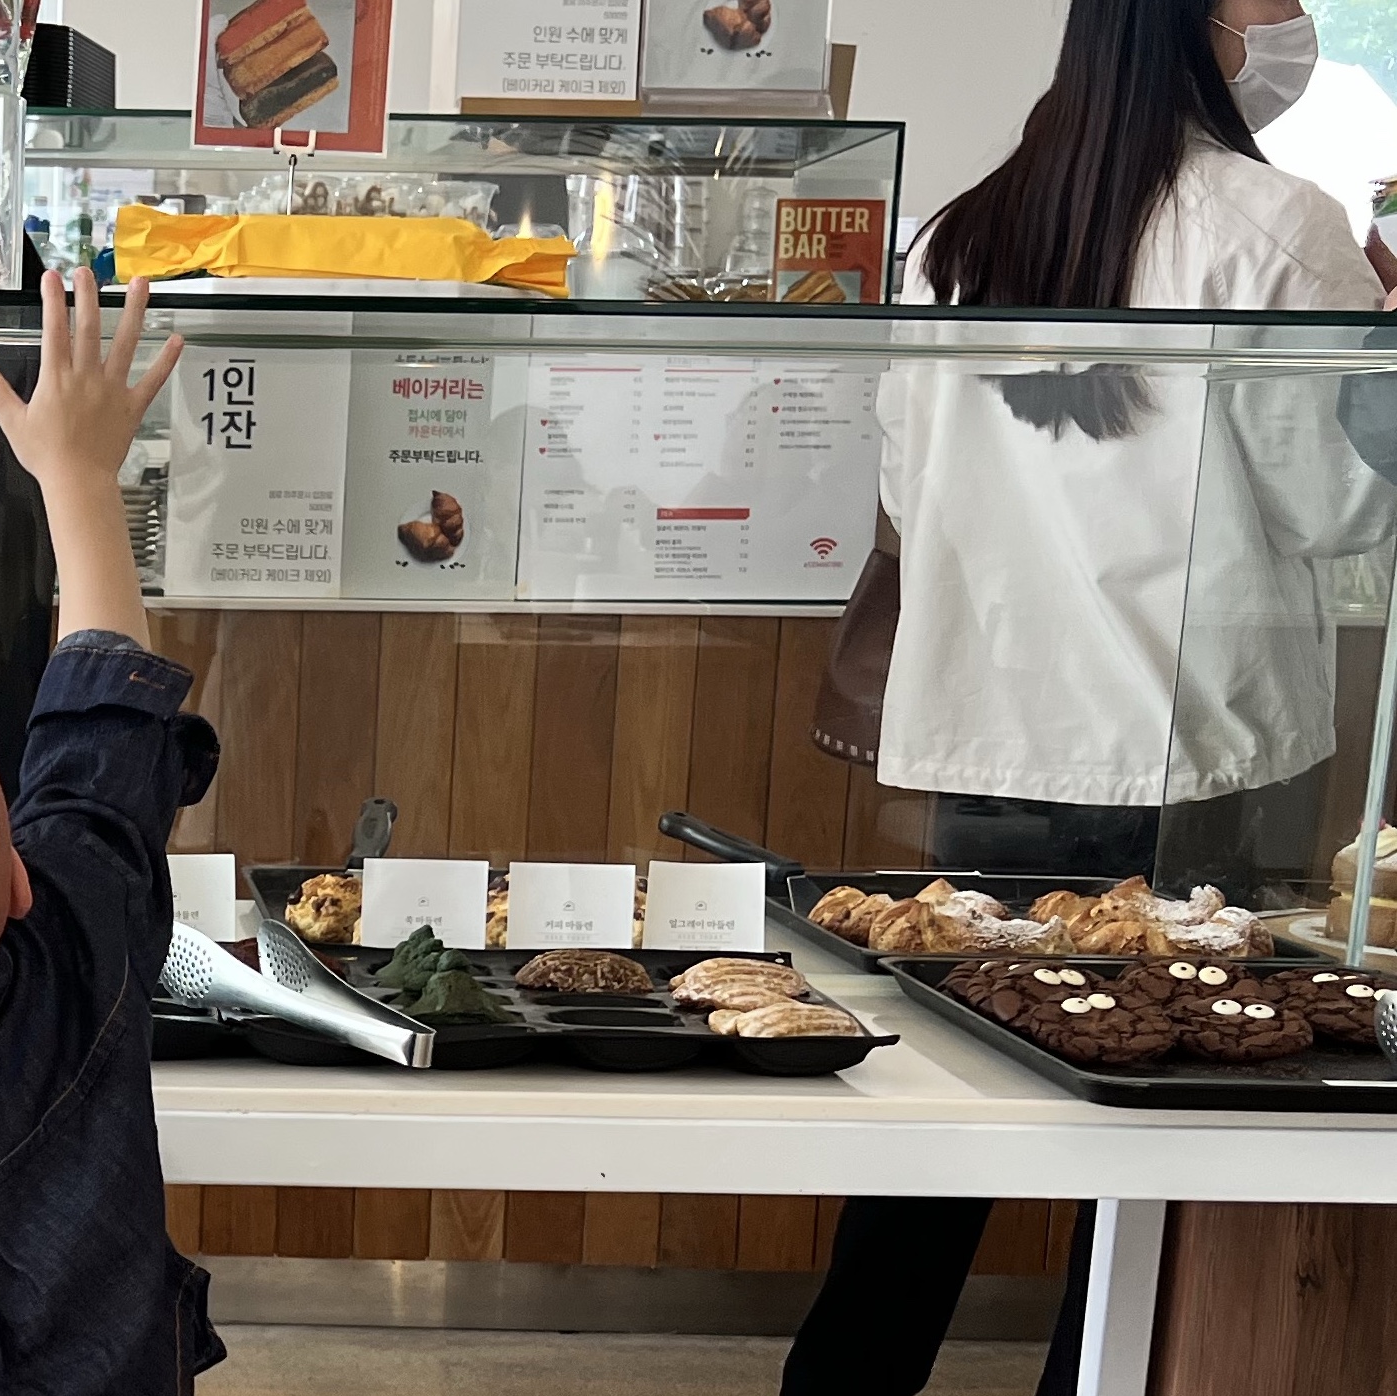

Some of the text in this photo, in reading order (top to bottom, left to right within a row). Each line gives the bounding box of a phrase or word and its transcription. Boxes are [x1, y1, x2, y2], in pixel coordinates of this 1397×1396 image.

[532, 25, 628, 44] 인원 수에 맞게
[503, 52, 532, 70] 주문
[780, 206, 870, 233] BUTTER
[778, 233, 827, 259] BAR
[202, 366, 255, 405] 1인
[392, 377, 485, 400] 베이커리는
[408, 408, 442, 423] 접시에
[201, 409, 257, 449] 1잔
[240, 518, 333, 536] 인원 수에 맞게
[211, 542, 239, 561] 주문
